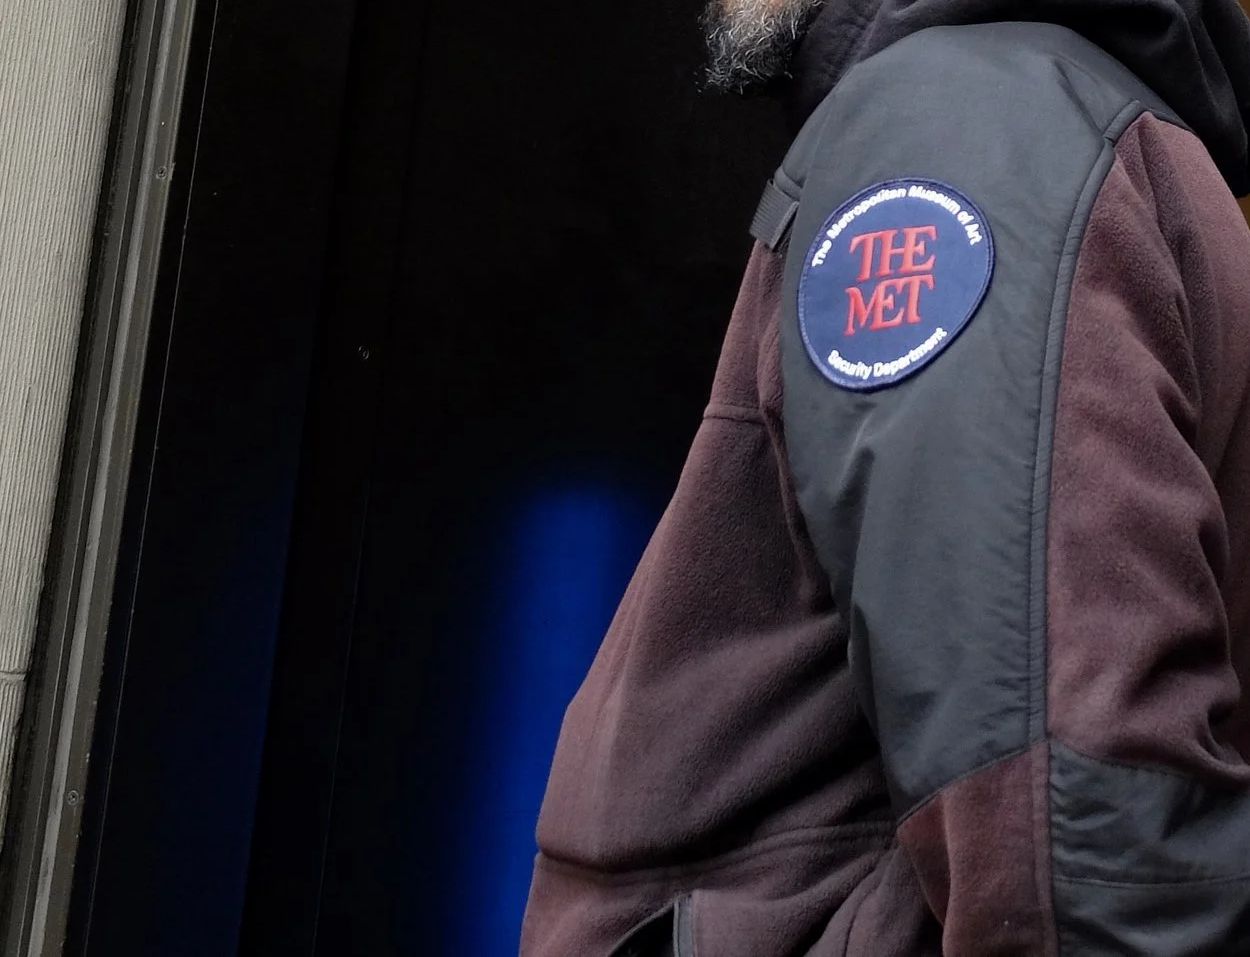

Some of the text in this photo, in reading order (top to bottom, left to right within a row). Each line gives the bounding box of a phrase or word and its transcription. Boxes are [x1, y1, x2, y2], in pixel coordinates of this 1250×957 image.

[957, 210, 975, 226] of
[964, 223, 983, 246] Art
[812, 239, 832, 266] The
[849, 225, 936, 282] THE
[843, 273, 934, 337] MET
[828, 349, 872, 380] Security
